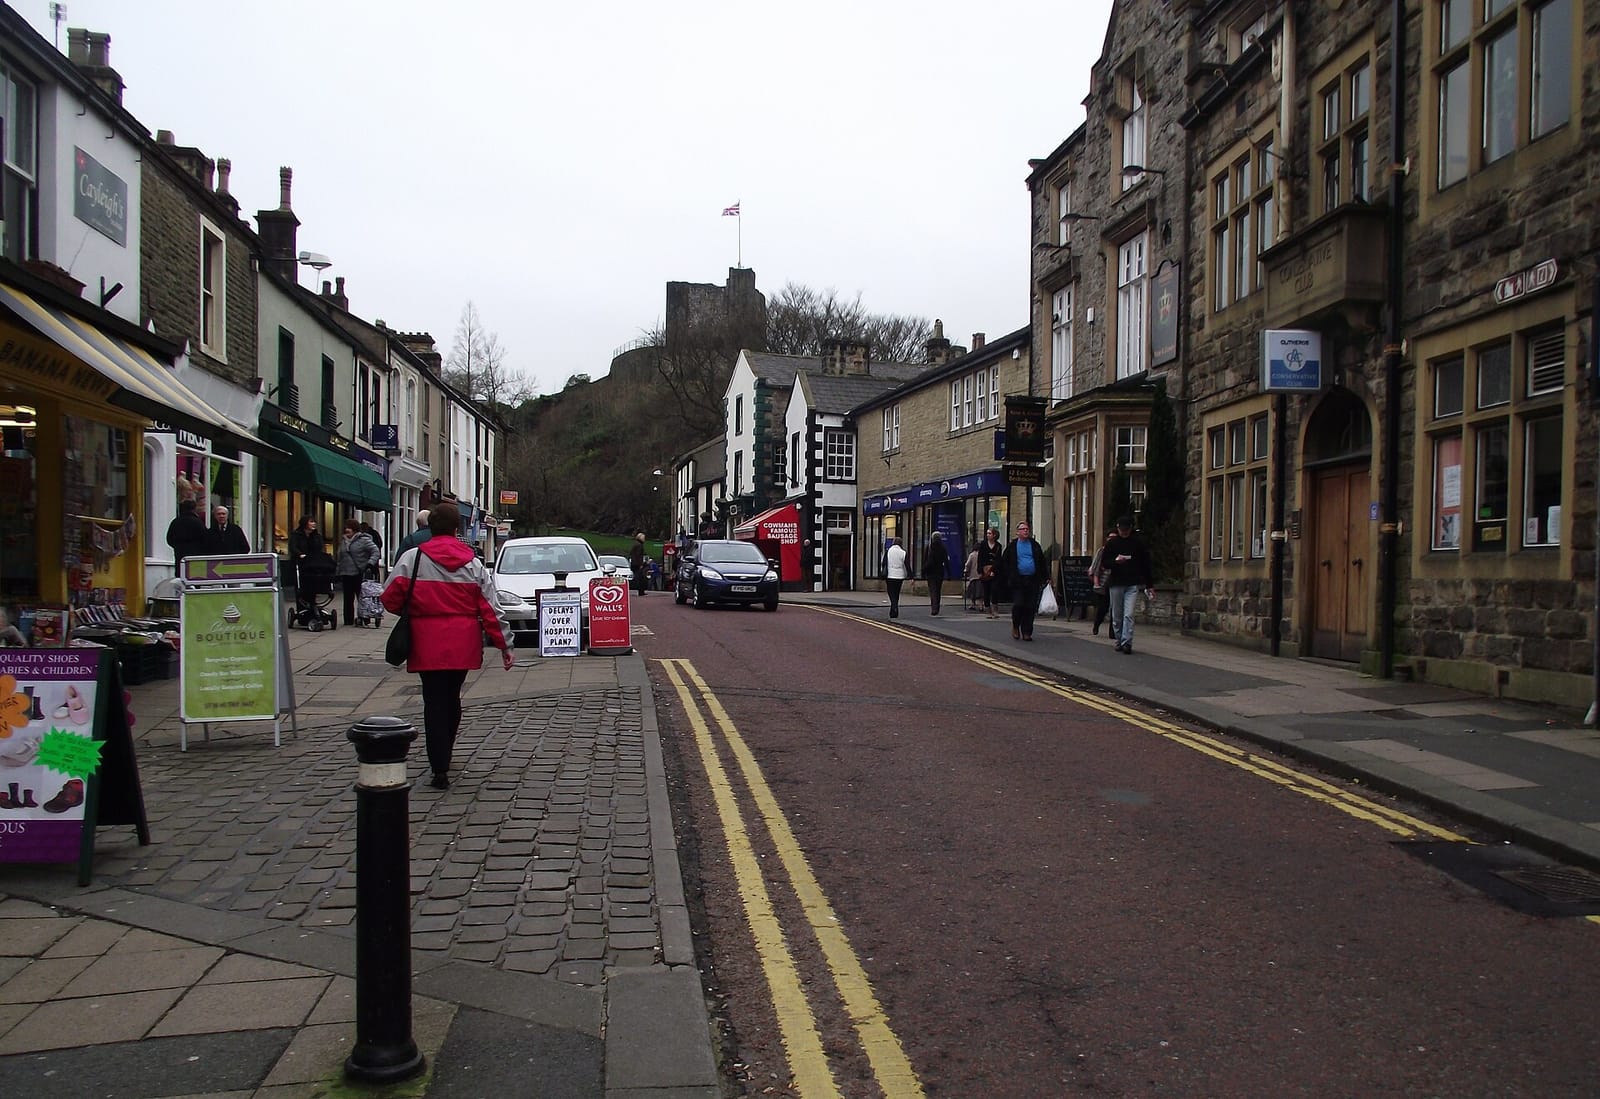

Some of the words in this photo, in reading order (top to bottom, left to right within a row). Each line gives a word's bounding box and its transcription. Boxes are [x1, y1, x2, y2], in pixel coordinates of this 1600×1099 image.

[80, 174, 124, 219] Cayleigh's
[0, 339, 69, 382] BANANA
[71, 367, 112, 397] NEWS
[549, 606, 574, 614] DELAYS
[594, 604, 623, 612] WALL'S
[552, 617, 570, 625] OVER
[196, 630, 265, 642] BOUTIQUE
[550, 638, 572, 646] PLAN?
[0, 655, 45, 664] QUALITY
[48, 655, 79, 663] SHOES
[43, 667, 92, 675] CHILDREN
